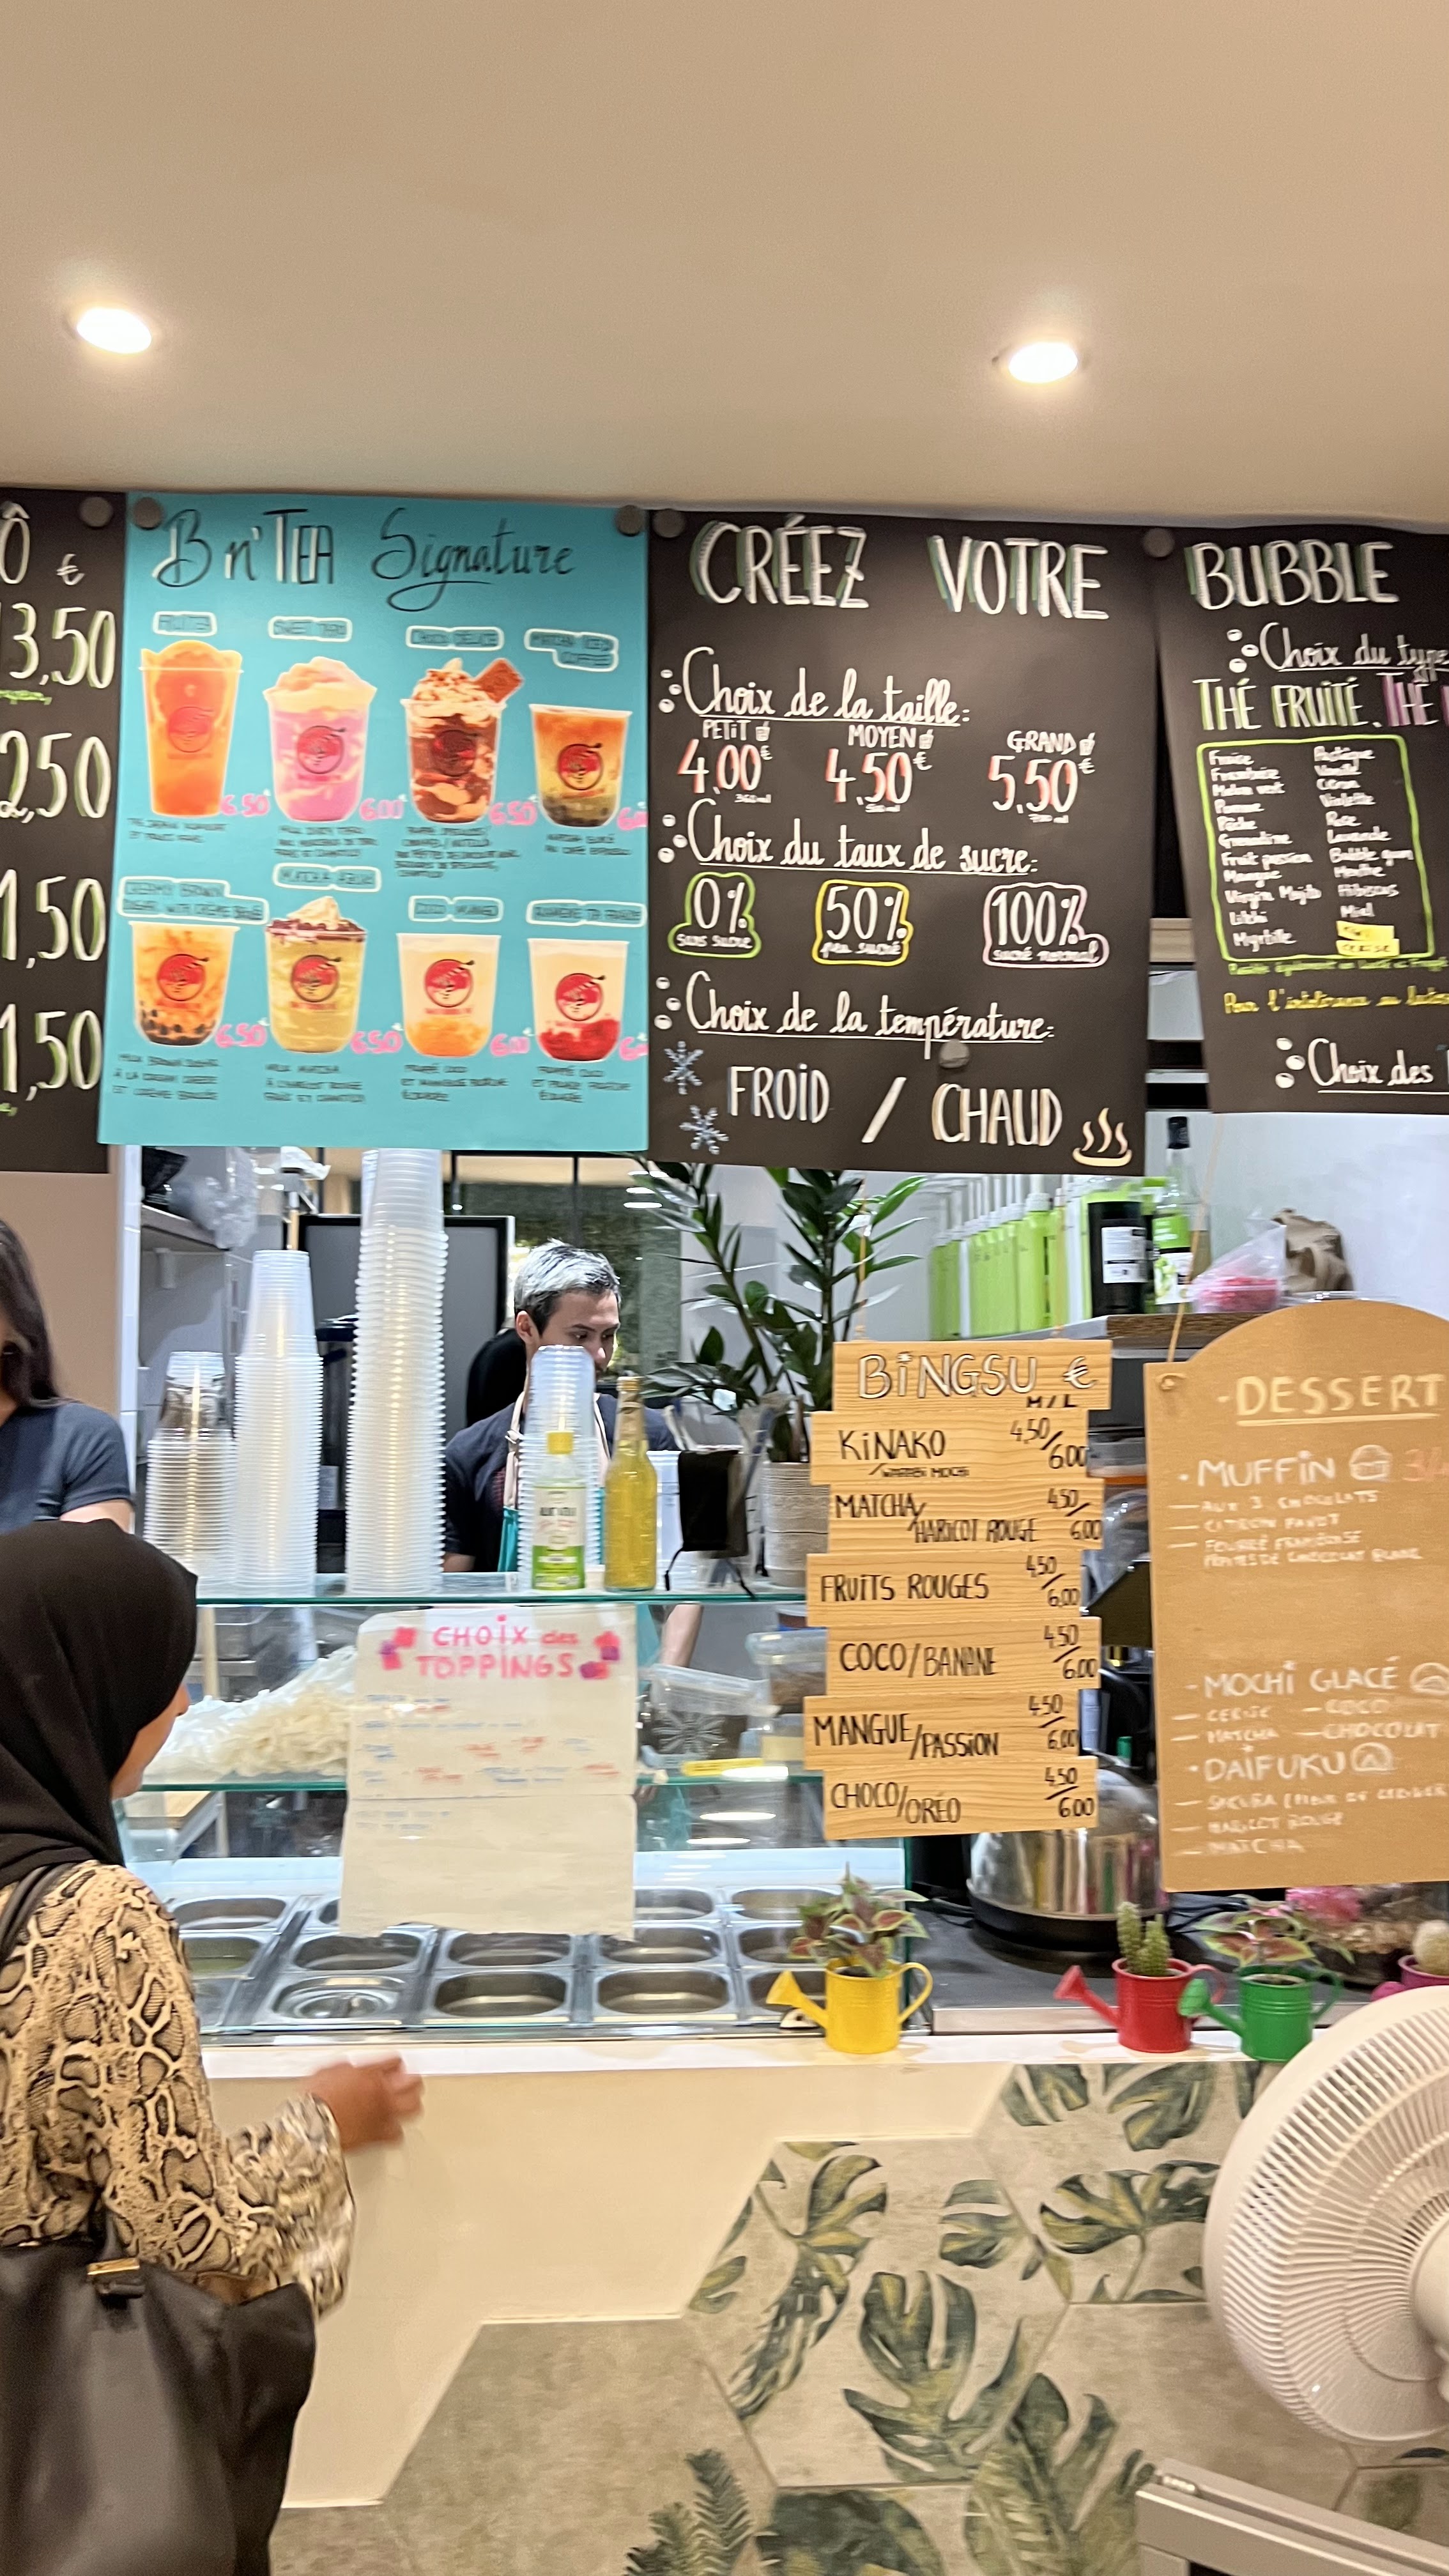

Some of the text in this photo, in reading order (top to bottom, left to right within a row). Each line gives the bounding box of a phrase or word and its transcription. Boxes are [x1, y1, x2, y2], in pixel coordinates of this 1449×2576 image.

[56, 553, 85, 585] €
[371, 507, 578, 611] Signature
[689, 514, 1109, 620] CRÉEZ VOTRE
[1184, 539, 1400, 610] BUBBLE
[0, 602, 116, 689] 3,50
[1260, 622, 1343, 670] Choix
[1353, 633, 1392, 666] du
[682, 647, 775, 716] Choix
[784, 668, 829, 719] de
[834, 668, 873, 721] la
[1192, 677, 1261, 730] THÉ
[848, 724, 917, 748] MOYEN
[1007, 731, 1078, 755] GRAND
[687, 799, 774, 864] Choix
[780, 818, 825, 866] du
[834, 824, 903, 868] taux
[912, 827, 946, 871] de
[694, 878, 747, 933] 0%
[826, 885, 907, 940] 50%
[992, 891, 1079, 946] 100%
[686, 970, 770, 1032] Choix
[776, 991, 820, 1034] de
[829, 991, 869, 1034] la
[1308, 1038, 1434, 1086] Choix des
[931, 1083, 1063, 1147] CHAUD
[1062, 1356, 1098, 1390] €
[908, 1572, 990, 1600] ROUGES
[416, 1652, 574, 1680] TOPPINGS
[1309, 1655, 1401, 1692] GLACÉ
